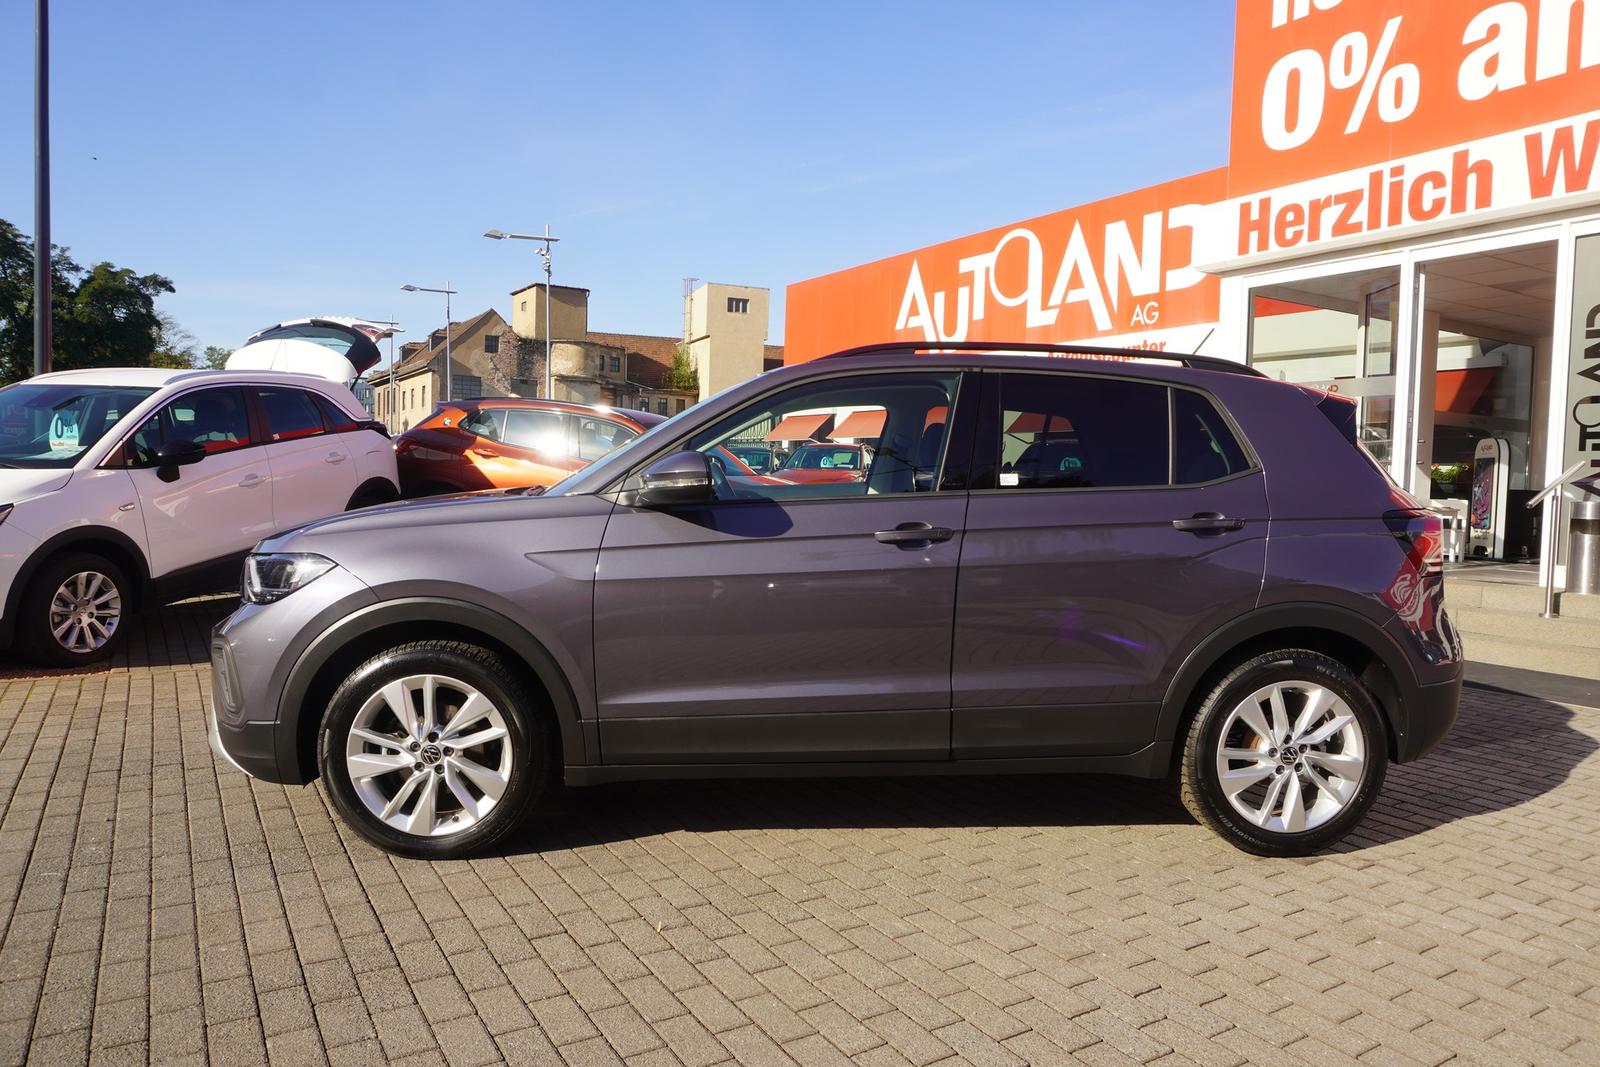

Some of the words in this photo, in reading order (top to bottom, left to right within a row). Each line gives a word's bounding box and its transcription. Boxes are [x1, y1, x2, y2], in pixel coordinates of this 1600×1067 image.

[1261, 15, 1420, 151] 0%
[1237, 148, 1493, 256] Herzlich
[1130, 301, 1160, 327] AG
